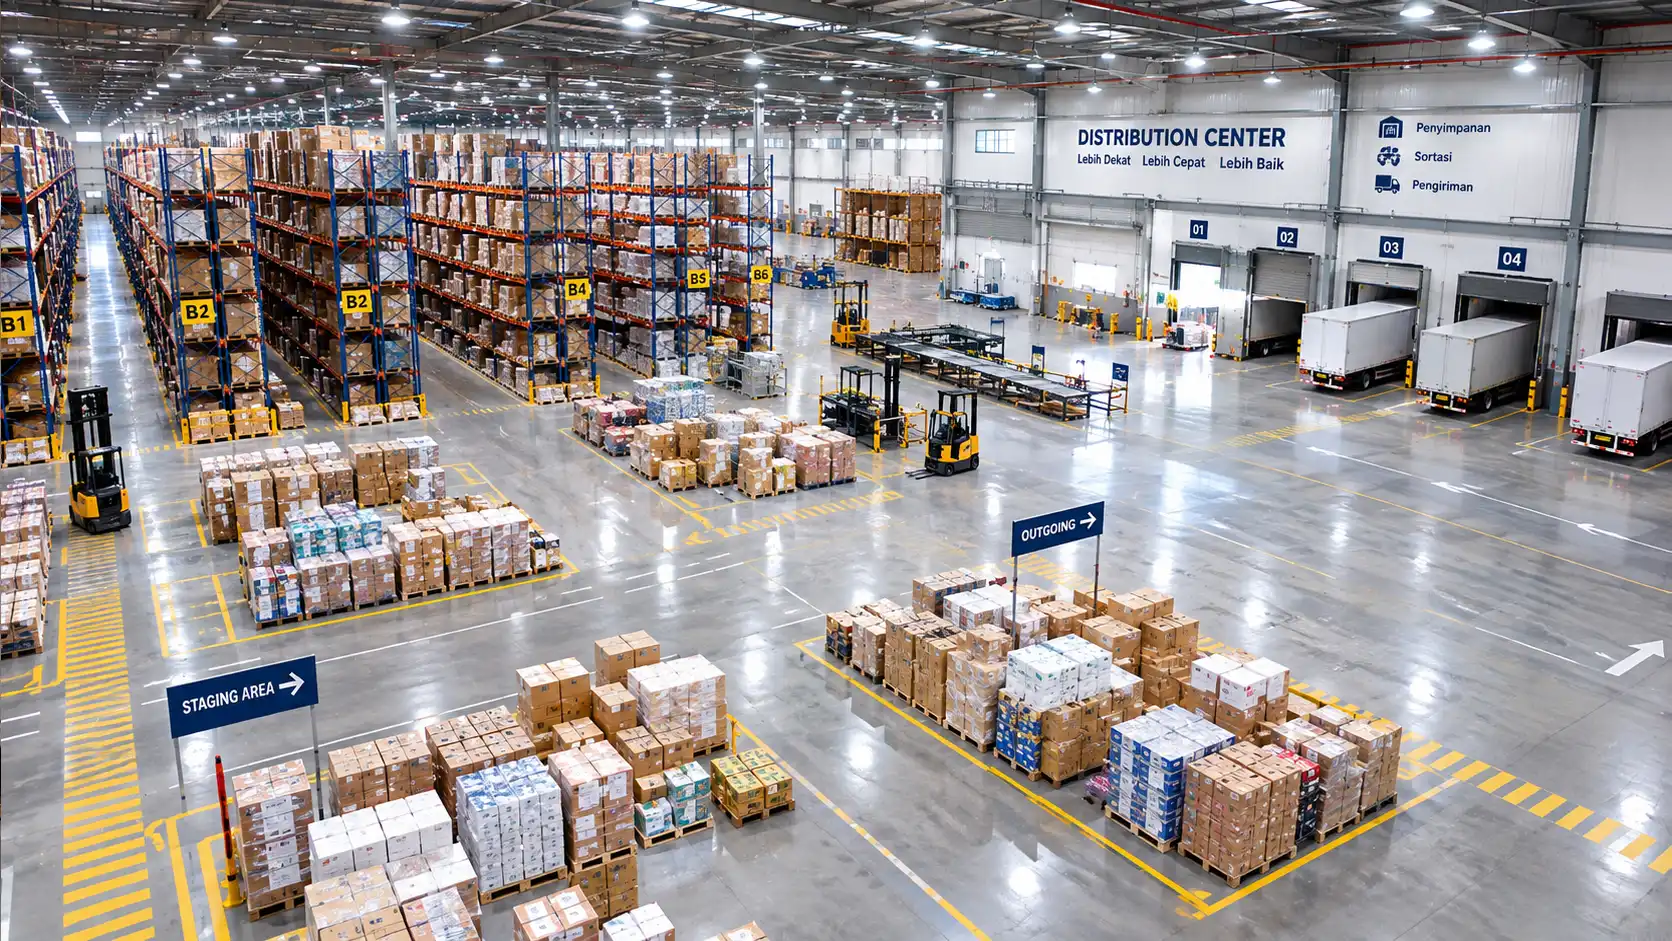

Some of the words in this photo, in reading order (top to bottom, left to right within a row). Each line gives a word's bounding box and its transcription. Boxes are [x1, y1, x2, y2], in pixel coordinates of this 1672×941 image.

[1416, 122, 1491, 135] Penyimpanan
[1078, 128, 1198, 147] DISTRIBUTION
[1204, 127, 1286, 147] CENTER
[1077, 154, 1101, 165] Lebih
[1103, 154, 1131, 166] Dekat
[1142, 155, 1170, 167] Lebih
[1173, 156, 1206, 170] Cepat
[1220, 157, 1253, 170] Lebih
[1256, 157, 1285, 170] Baik
[1414, 151, 1453, 162] Sortasi
[1412, 180, 1474, 193] Pengiriman
[1193, 224, 1204, 236] 01
[1280, 231, 1294, 244] 02
[1383, 241, 1400, 254] 03
[1502, 252, 1522, 266] 04
[754, 269, 769, 280] B6
[568, 283, 586, 296] B4
[346, 295, 368, 310] B2
[185, 305, 210, 320] B2
[1, 315, 26, 332] B1
[1021, 519, 1076, 542] OUTGOING
[182, 689, 238, 714] STAGING
[241, 681, 275, 701] AREA
